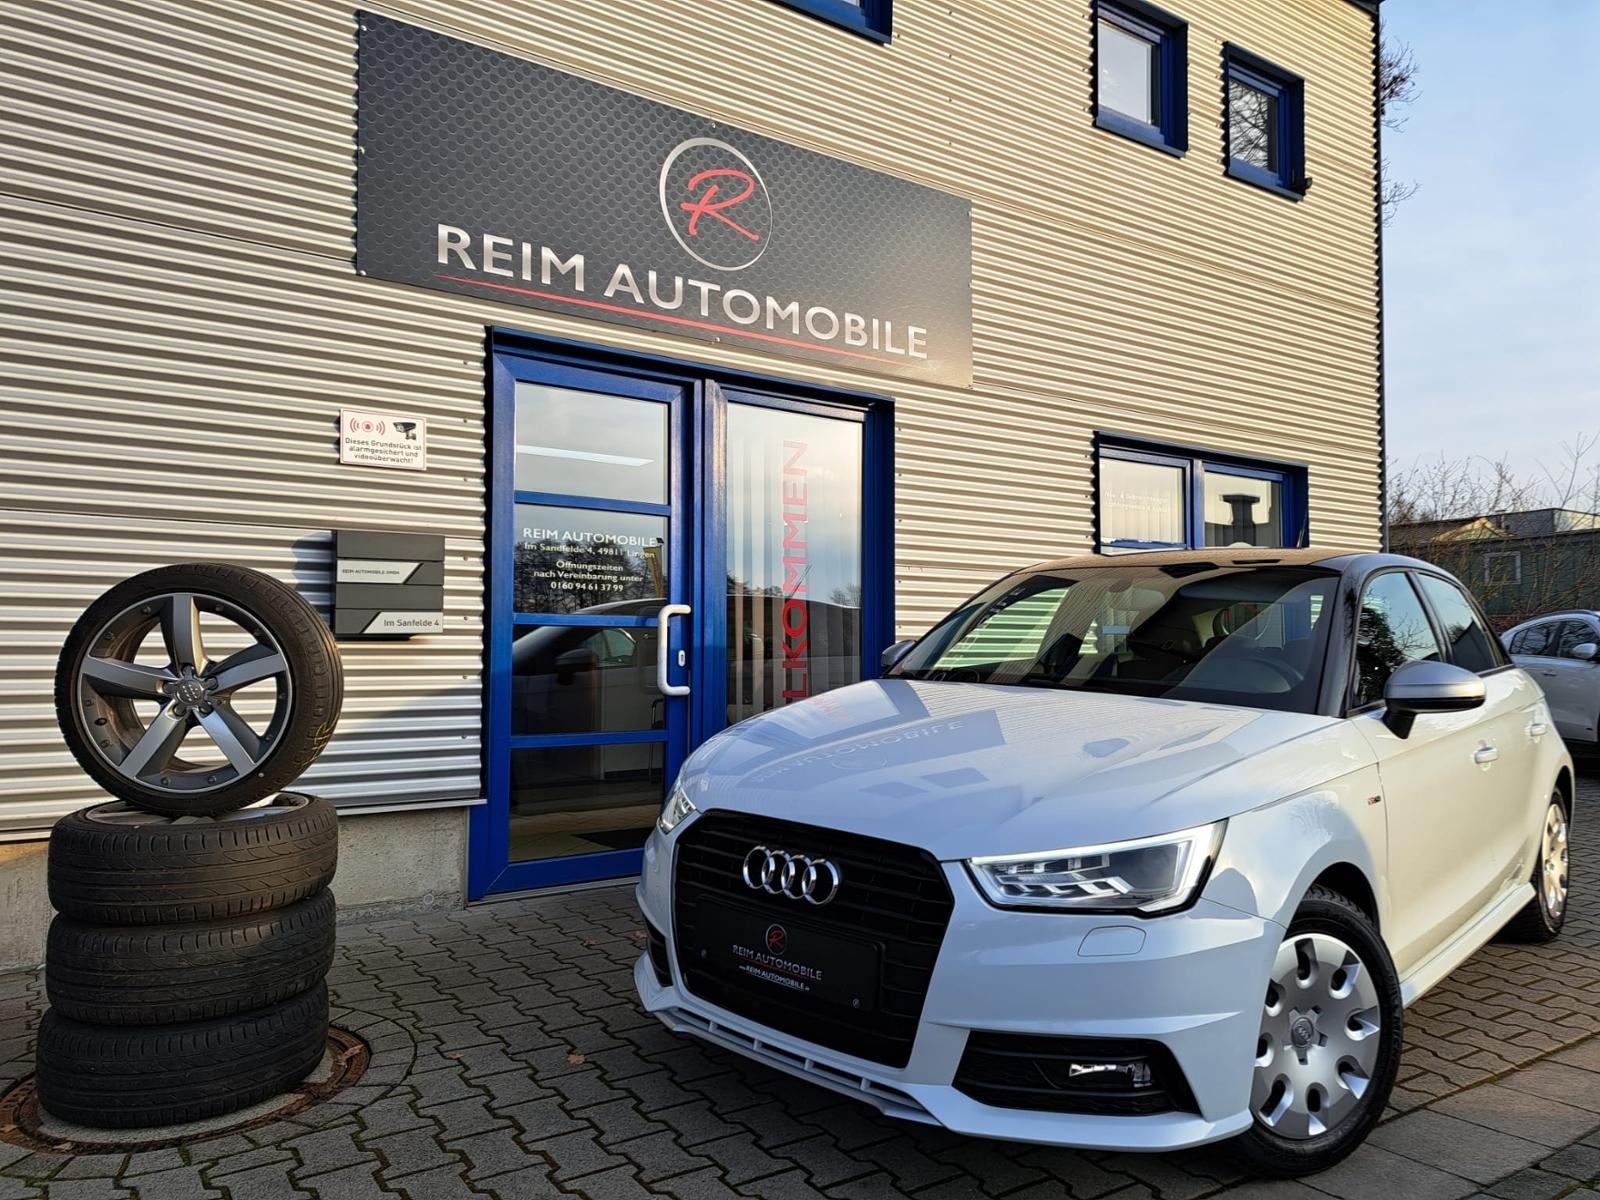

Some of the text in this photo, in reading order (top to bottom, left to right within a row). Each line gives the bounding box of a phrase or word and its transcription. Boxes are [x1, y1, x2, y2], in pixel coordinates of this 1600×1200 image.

[680, 168, 760, 241] R
[437, 223, 929, 360] REIM AUTOMOBILE
[345, 437, 370, 446] Dieses
[349, 446, 404, 456] alarmgesichert
[354, 453, 414, 464] videoüberwacht!
[523, 528, 658, 547] REIM AUTOMOBILE
[524, 542, 537, 550] Im
[540, 543, 585, 554] Sandfelde
[598, 547, 623, 556] 49811
[627, 549, 655, 559] Lingen
[533, 570, 556, 578] nach
[557, 570, 618, 583] Vereinbarung
[782, 440, 809, 701] LKOMMEN
[550, 581, 574, 590] 0160
[575, 582, 587, 590] 94
[600, 583, 612, 591] 37
[612, 584, 624, 592] 99
[384, 619, 394, 627] Im
[732, 944, 823, 981] REIM AUTOMOBILE
